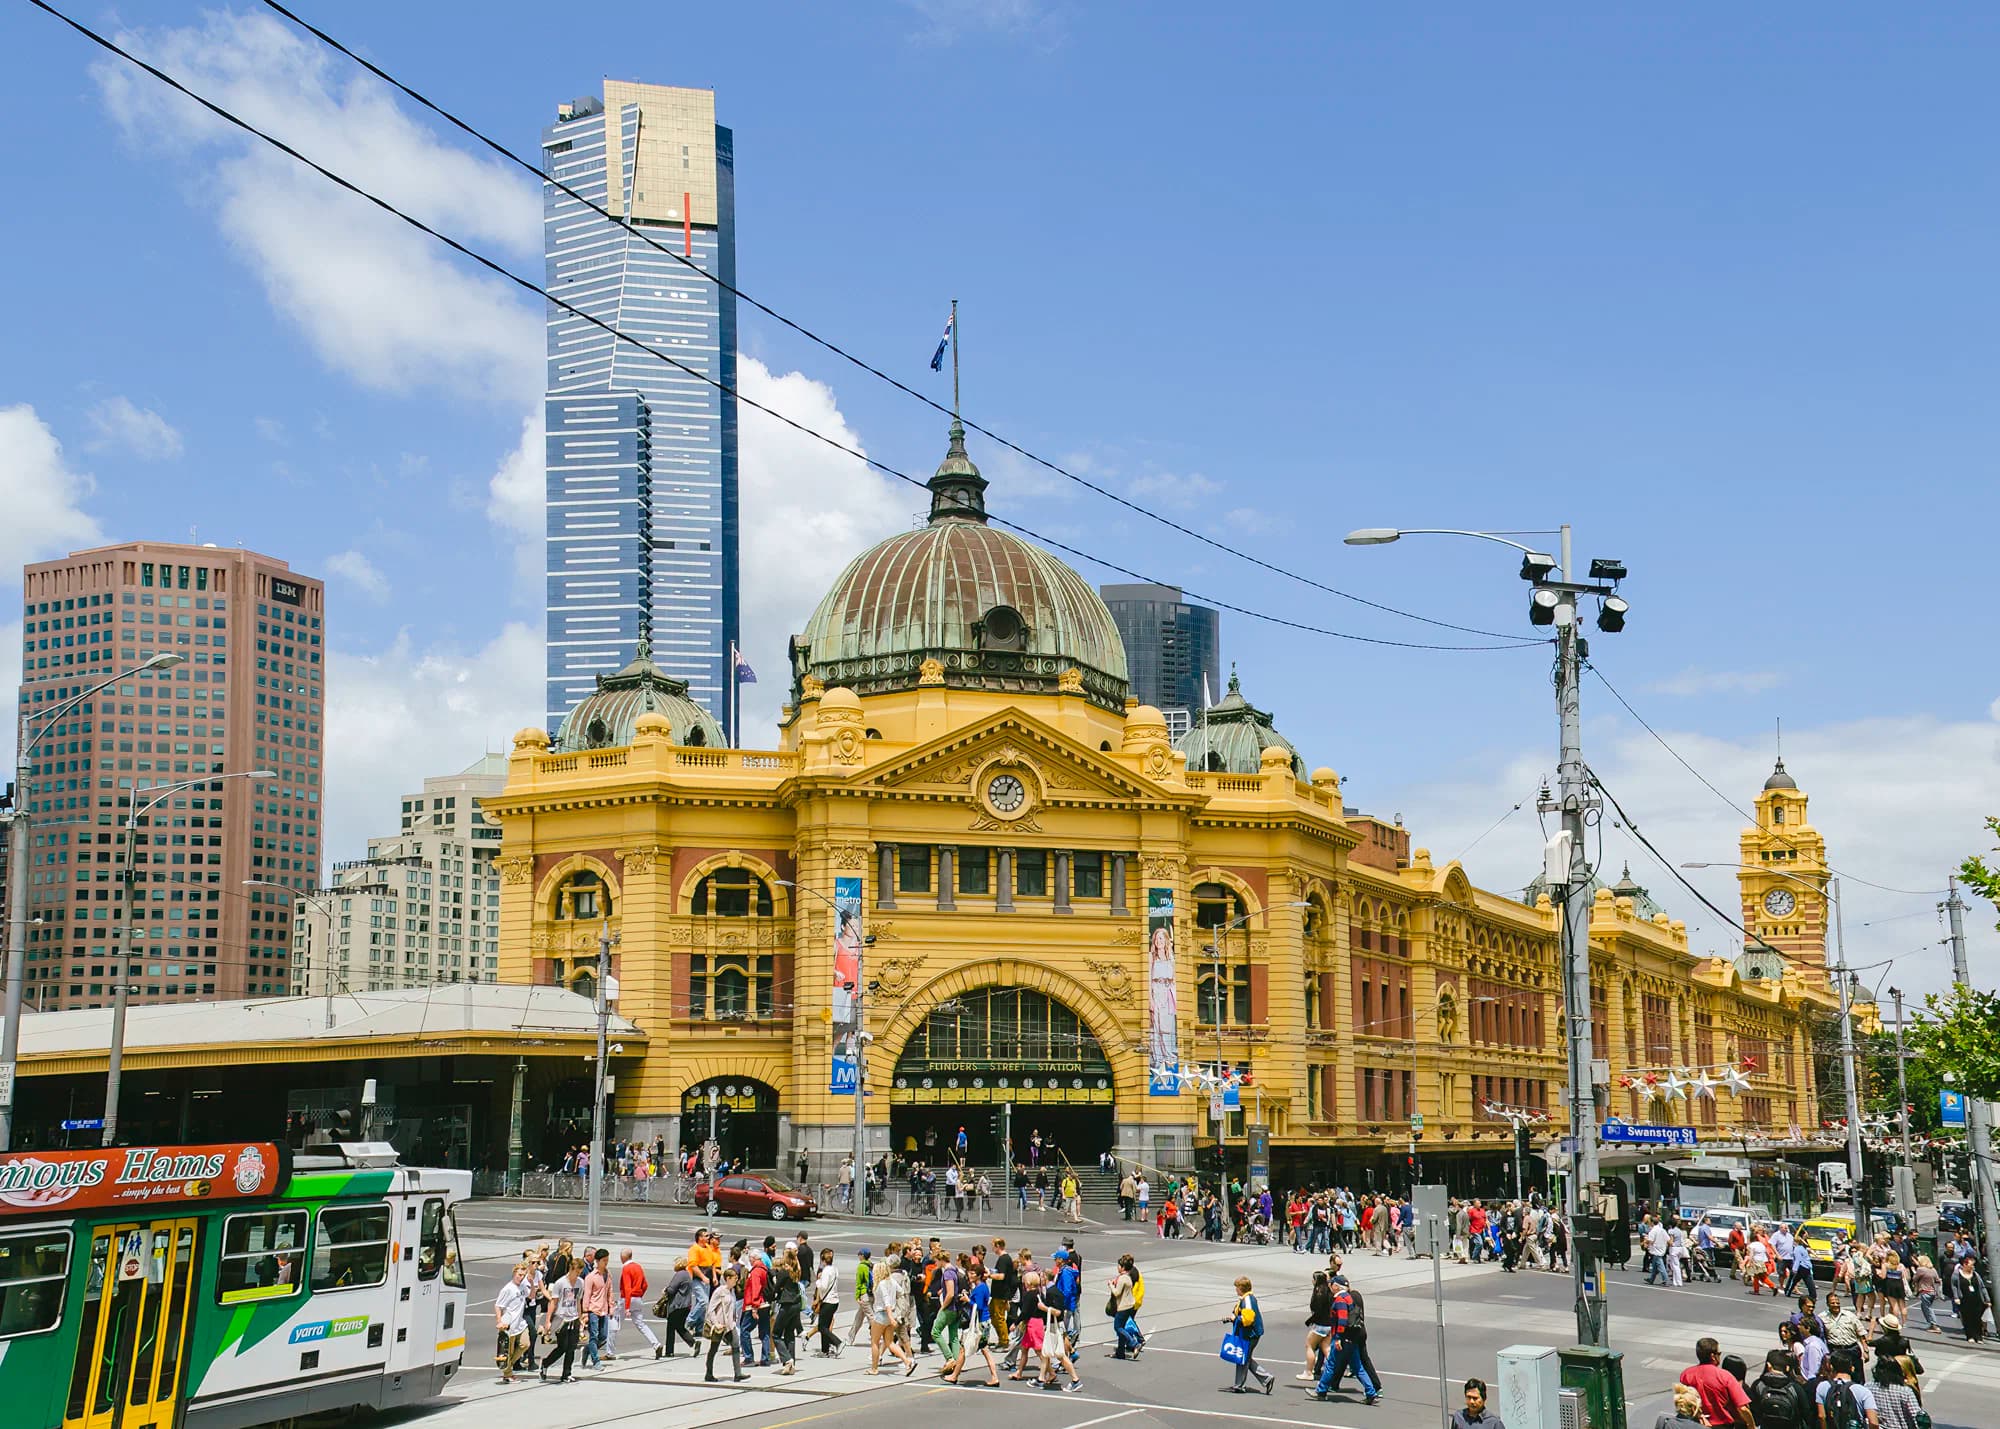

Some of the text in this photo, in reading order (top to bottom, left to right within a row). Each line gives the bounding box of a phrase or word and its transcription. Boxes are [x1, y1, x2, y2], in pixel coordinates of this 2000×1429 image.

[276, 582, 296, 597] IBM
[836, 887, 849, 896] my
[836, 896, 861, 904] metro
[1160, 898, 1173, 906] my
[929, 1063, 1082, 1072] FLINDERS STREET STATION
[1628, 1127, 1693, 1138] Swanston St
[115, 1148, 225, 1184] Hams
[152, 1185, 165, 1195] the
[295, 1319, 364, 1341] yarra trams
